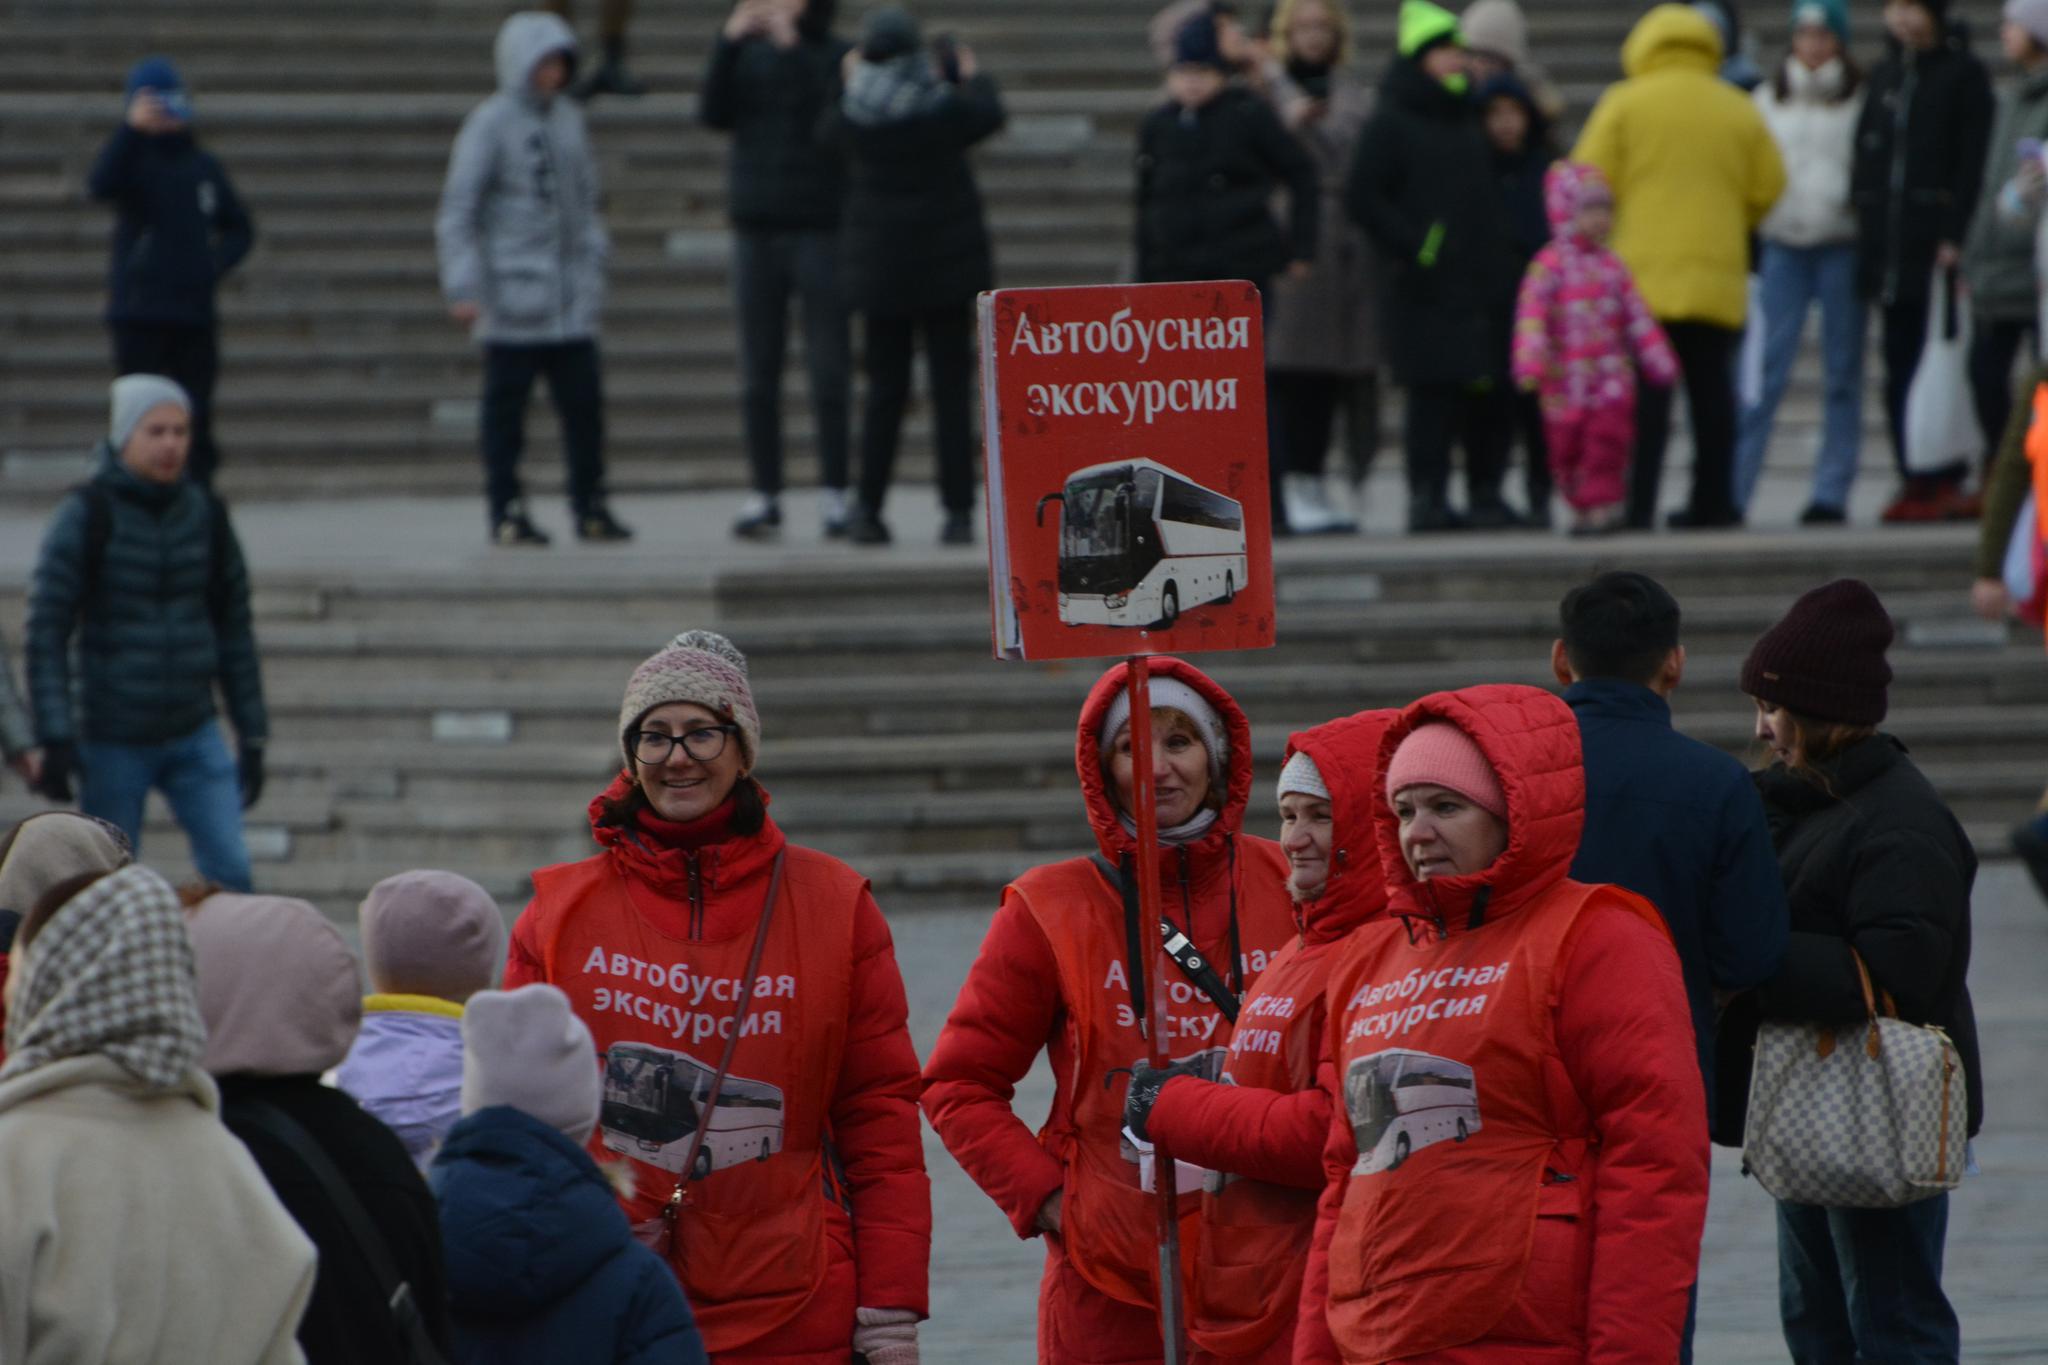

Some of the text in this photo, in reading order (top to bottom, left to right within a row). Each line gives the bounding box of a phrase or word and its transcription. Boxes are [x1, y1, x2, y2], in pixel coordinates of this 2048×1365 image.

[1010, 307, 1250, 364] Автобусная
[1027, 378, 1238, 425] экскурсия
[1346, 961, 1510, 1011] Автобусная
[593, 987, 782, 1044] экскурсия
